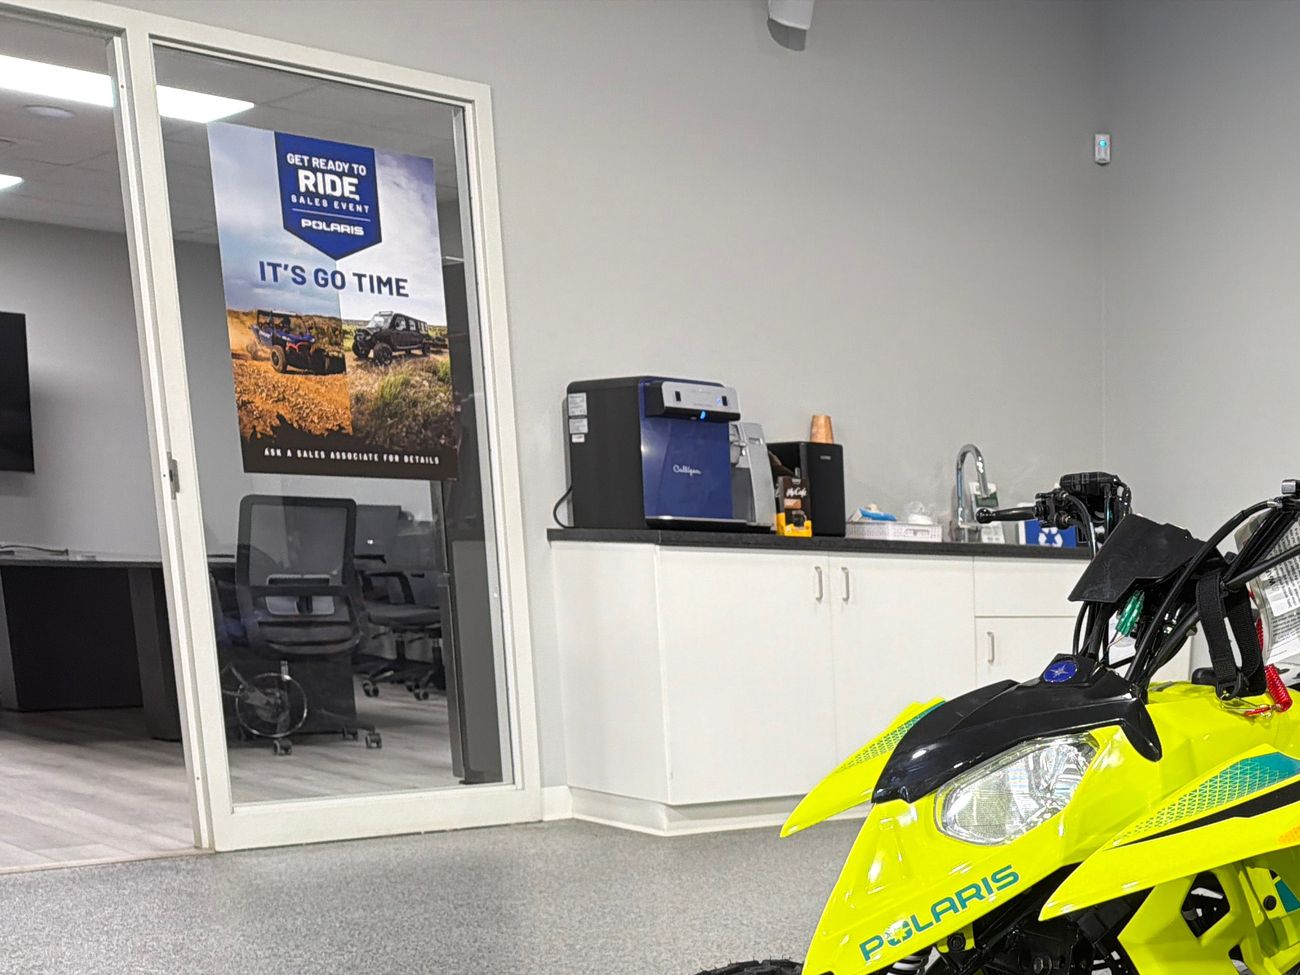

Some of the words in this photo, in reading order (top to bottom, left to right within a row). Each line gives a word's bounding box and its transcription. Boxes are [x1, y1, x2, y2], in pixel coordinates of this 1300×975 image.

[286, 152, 309, 167] GET
[311, 157, 349, 173] READY
[352, 163, 367, 176] TO
[298, 168, 360, 201] RIDE
[291, 194, 328, 208] SALES
[333, 200, 370, 214] EVENT
[301, 218, 365, 236] POLARIS
[259, 260, 307, 286] IT'S
[313, 267, 347, 291] GO
[352, 272, 410, 298] TIME
[264, 448, 282, 456] ASK
[287, 449, 292, 457] A
[297, 450, 325, 459] SALES
[330, 451, 379, 462] ASSOCIATE
[383, 454, 400, 462] FOR
[403, 455, 440, 465] DETAILS
[858, 865, 1020, 963] POLARIS
